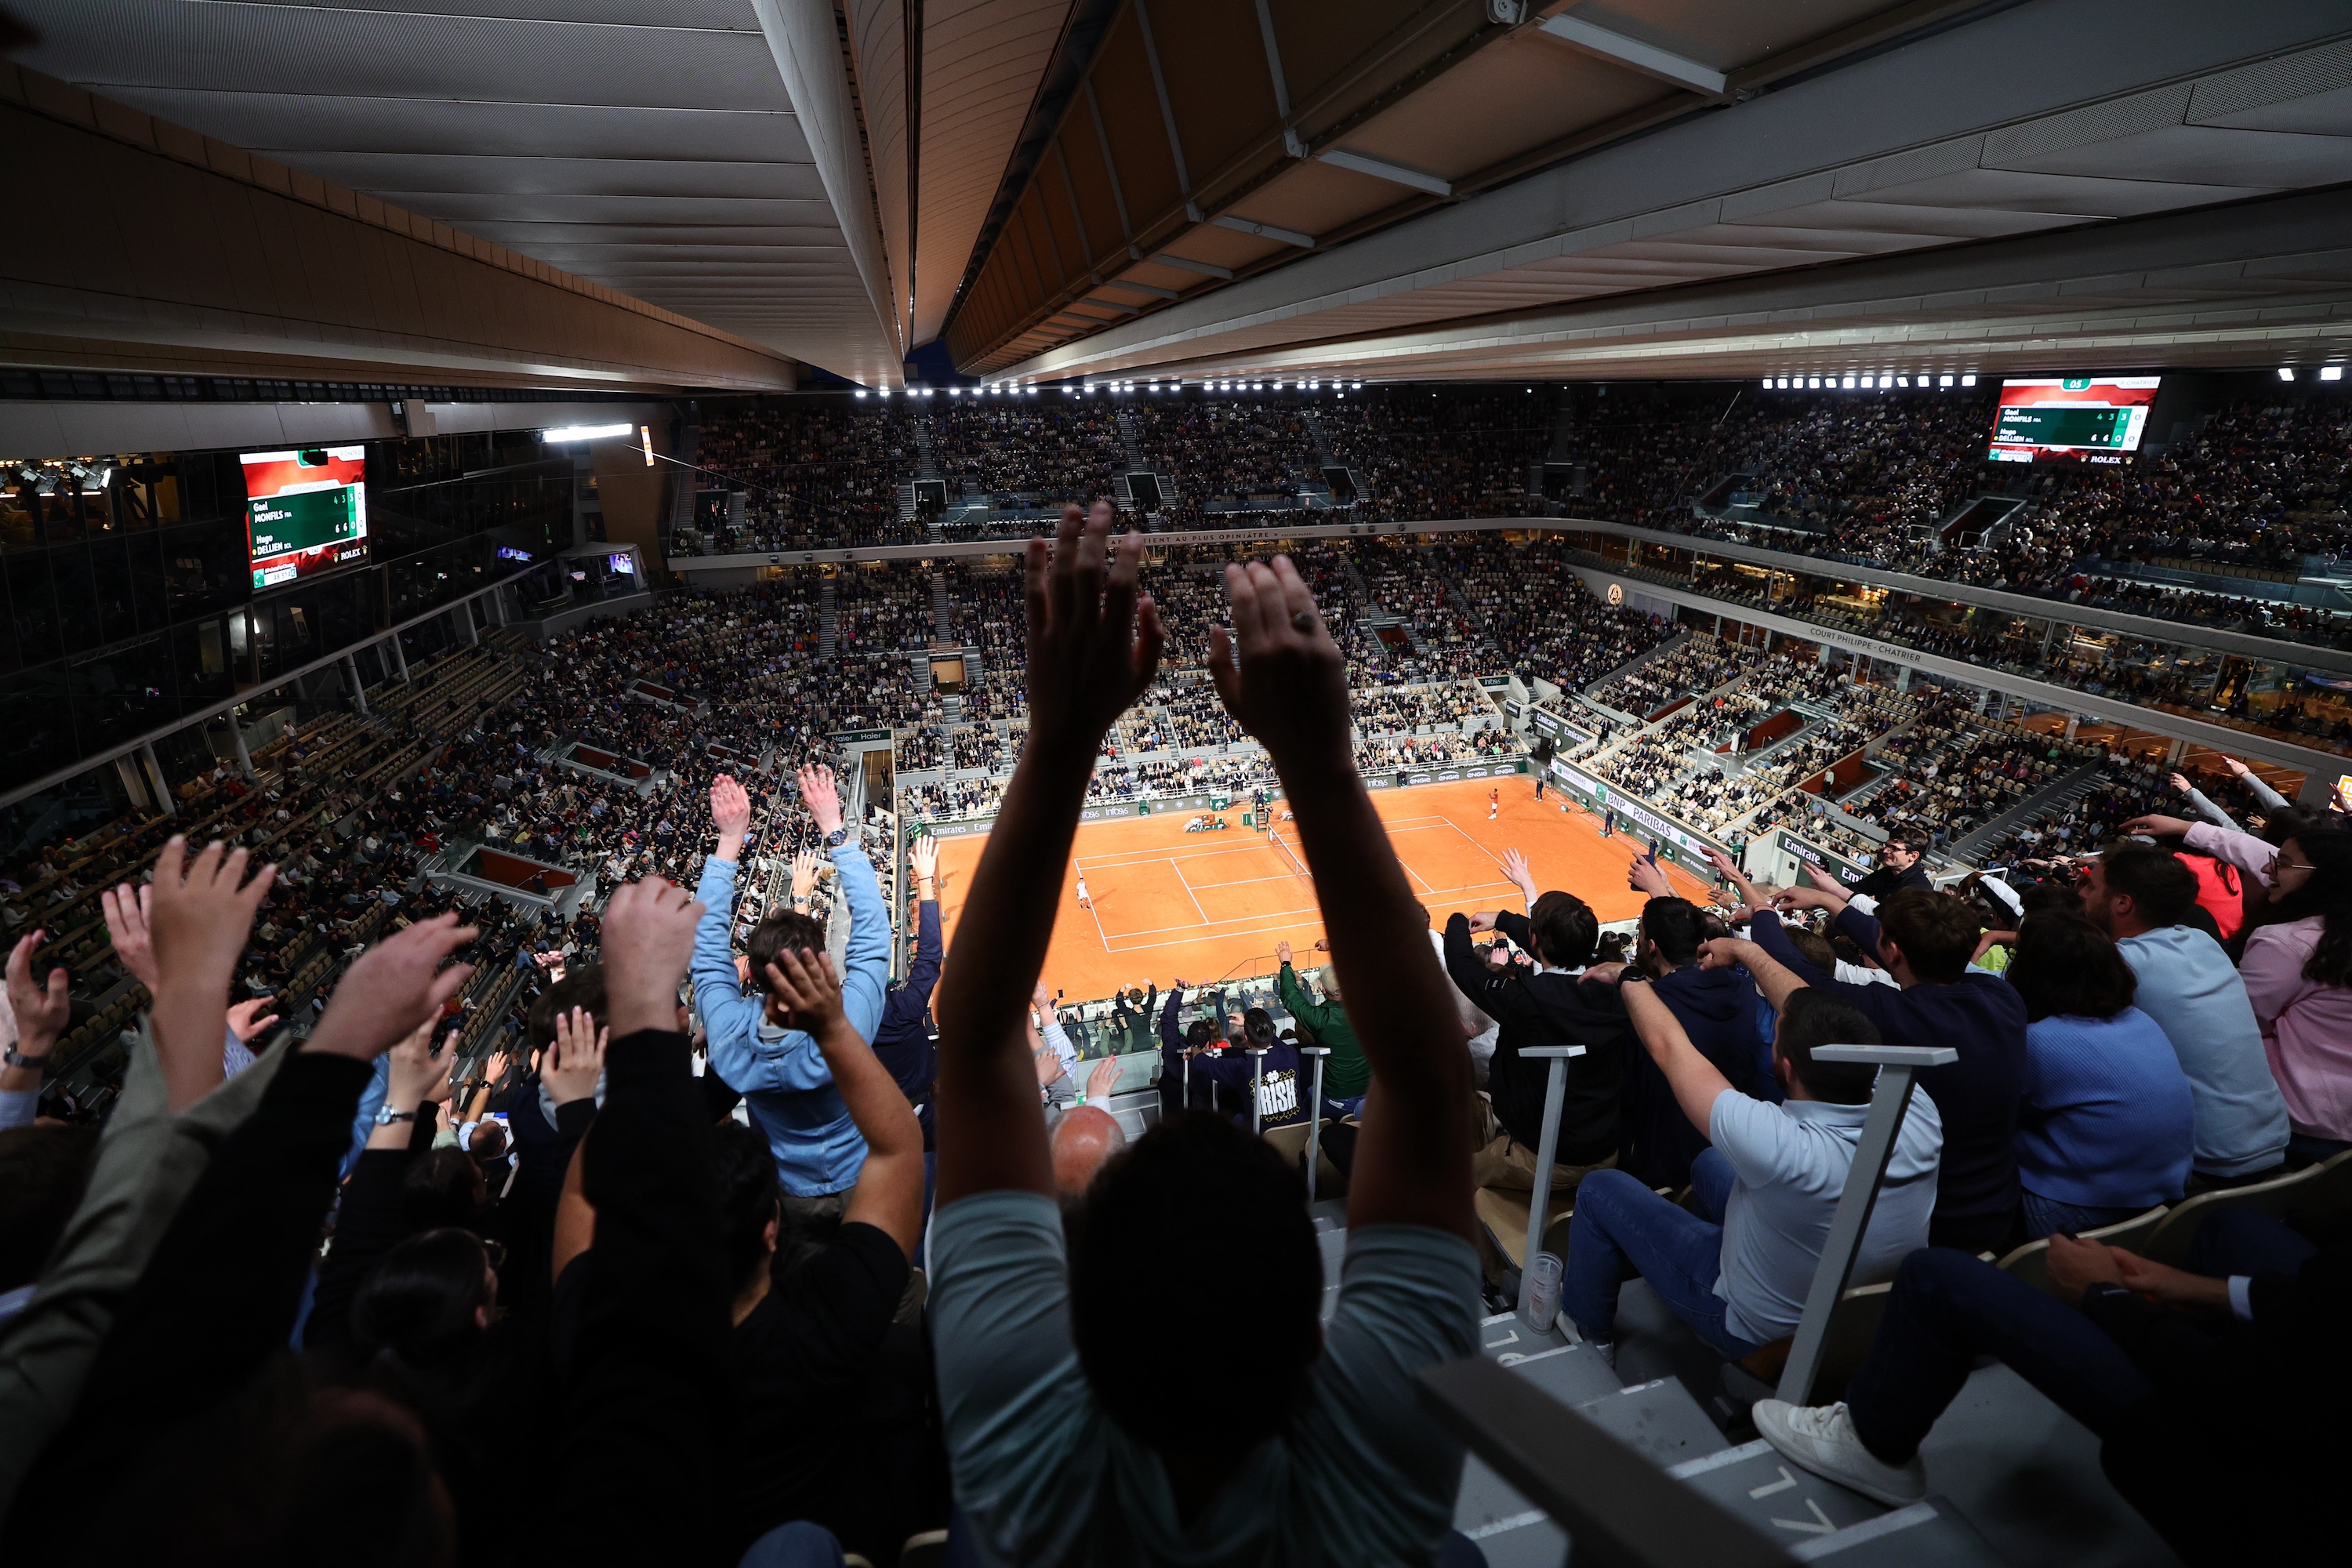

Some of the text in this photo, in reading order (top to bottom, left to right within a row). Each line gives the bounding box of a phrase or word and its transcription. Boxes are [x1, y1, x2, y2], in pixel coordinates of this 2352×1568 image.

[2070, 379, 2082, 389] 05
[2090, 456, 2122, 464] ROLEX
[333, 496, 338, 505] 4
[342, 495, 346, 503] 3
[349, 493, 354, 503] 3
[253, 501, 269, 512] Gael
[254, 510, 284, 523] MONFILS
[335, 524, 339, 534] 6
[343, 522, 348, 532] 6
[256, 535, 273, 546] Hugo
[1111, 536, 1171, 545] APTIENT
[1219, 531, 1269, 540] OPINIÂTRE
[257, 542, 283, 556] DELLIEN
[340, 548, 361, 561] ROLEX
[1810, 628, 1835, 640] COURT
[1837, 634, 1871, 649] PHILIPPE
[1878, 645, 1922, 662] CHATRIER
[1537, 713, 1559, 730] Emirates
[1564, 726, 1588, 743] Emirates
[1367, 779, 1388, 787] Infosys
[1570, 772, 1586, 785] PARIBAS
[1566, 786, 1580, 797] PARIBAS
[1080, 810, 1100, 818] nfosys
[1105, 808, 1129, 816] Infosys
[1608, 793, 1671, 837] BNP PARIBAS
[931, 826, 967, 836] Emirates
[1688, 839, 1700, 848] BNP
[1784, 837, 1820, 865] Emirate
[1690, 860, 1708, 874] PARIBAS
[1253, 1078, 1298, 1116] RISH
